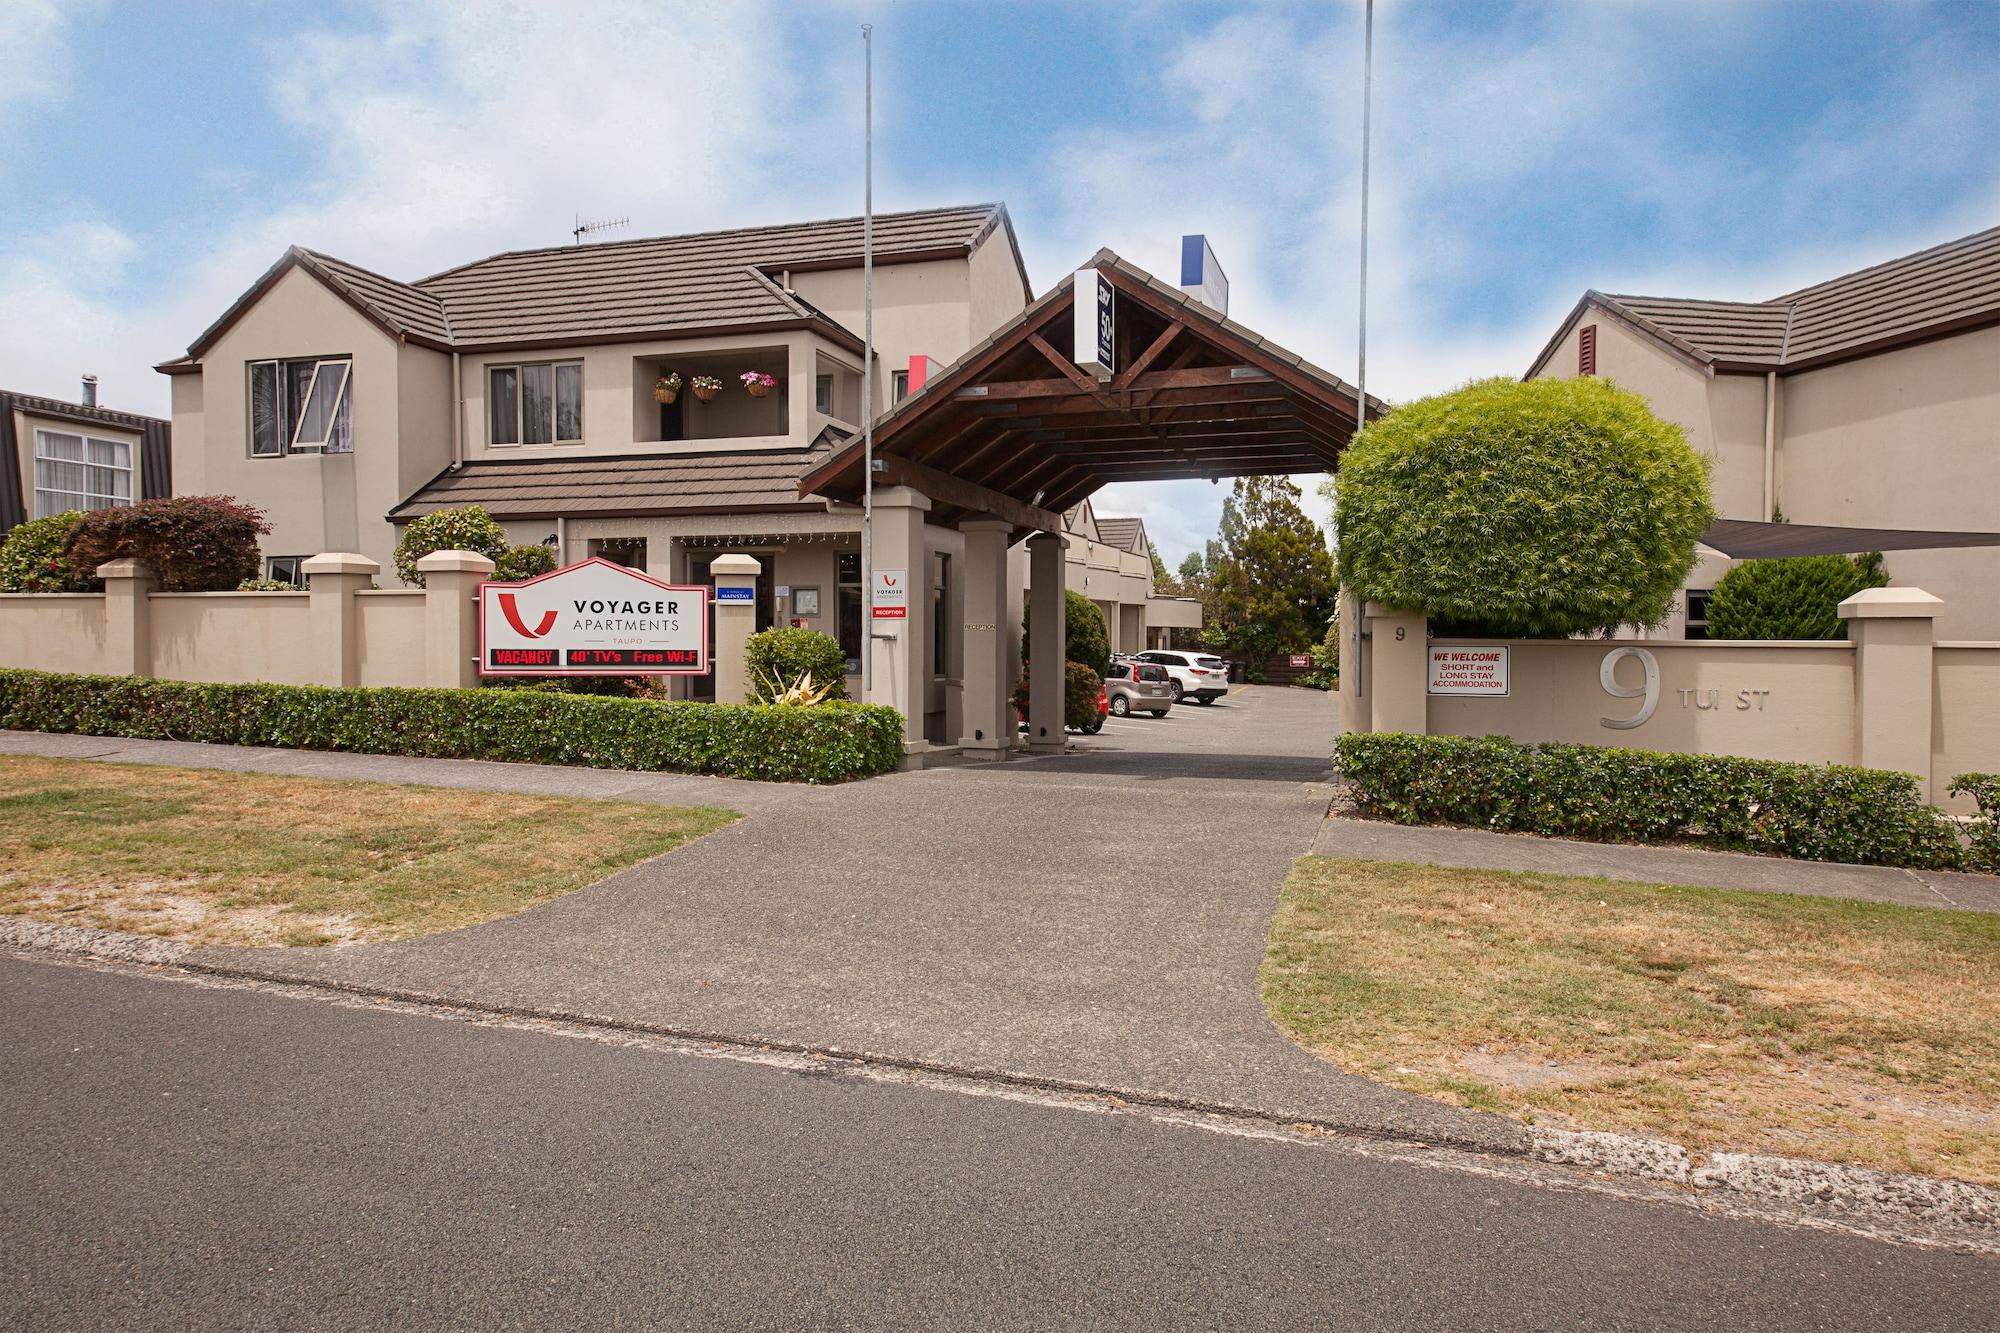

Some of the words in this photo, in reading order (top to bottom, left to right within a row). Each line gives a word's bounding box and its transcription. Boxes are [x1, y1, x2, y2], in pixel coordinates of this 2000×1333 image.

[573, 600, 679, 615] VOYAGER
[573, 619, 679, 632] APARTMENTS
[1395, 626, 1405, 641] 9
[612, 637, 643, 645] TAUPO
[495, 650, 552, 665] VACANCY
[593, 650, 622, 663] TV's
[633, 650, 663, 663] Free
[1434, 652, 1449, 662] WE
[1451, 652, 1501, 662] WELCOME
[1441, 663, 1475, 671] SHORT
[1470, 672, 1495, 680] STAY
[1432, 680, 1503, 688] ACCOMMODATION
[1599, 646, 1661, 730] 9
[1677, 688, 1720, 711] TUI
[1736, 689, 1770, 711] ST
